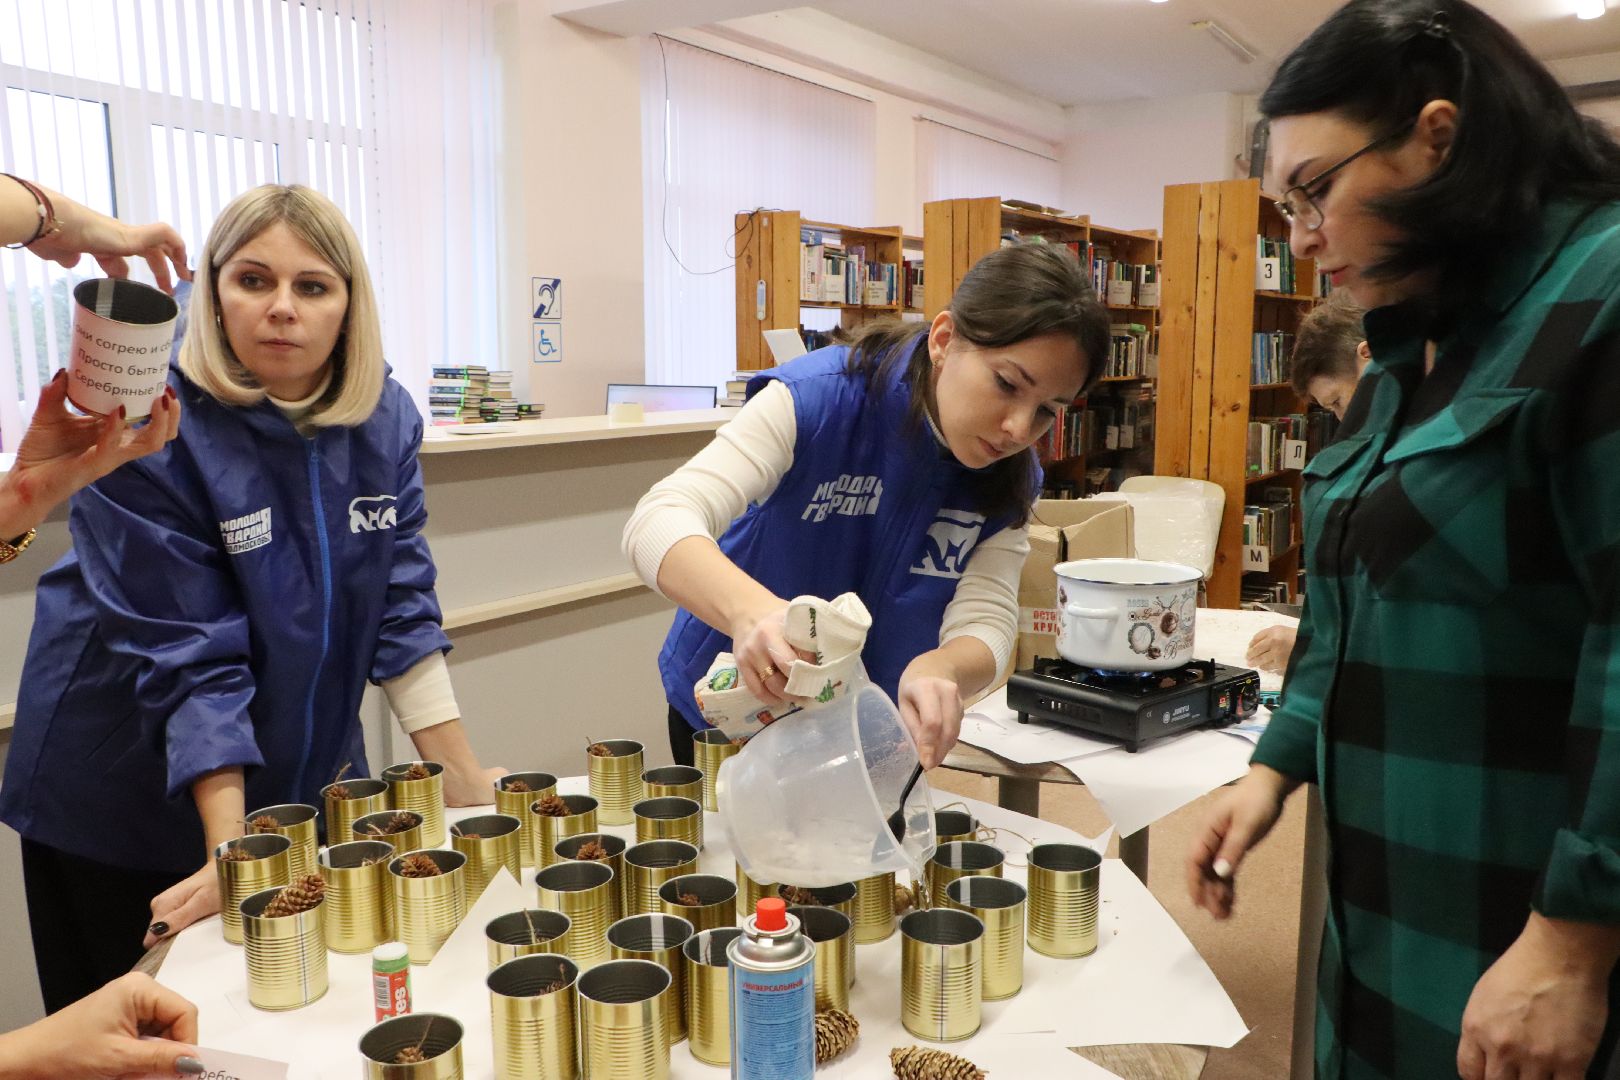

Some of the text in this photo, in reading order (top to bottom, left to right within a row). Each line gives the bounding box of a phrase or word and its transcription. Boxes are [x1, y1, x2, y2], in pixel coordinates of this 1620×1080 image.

[96, 338, 148, 355] согрею
[79, 347, 123, 374] Просто
[127, 364, 158, 377] быть
[75, 368, 154, 397] Серебряные
[1250, 548, 1263, 563] М
